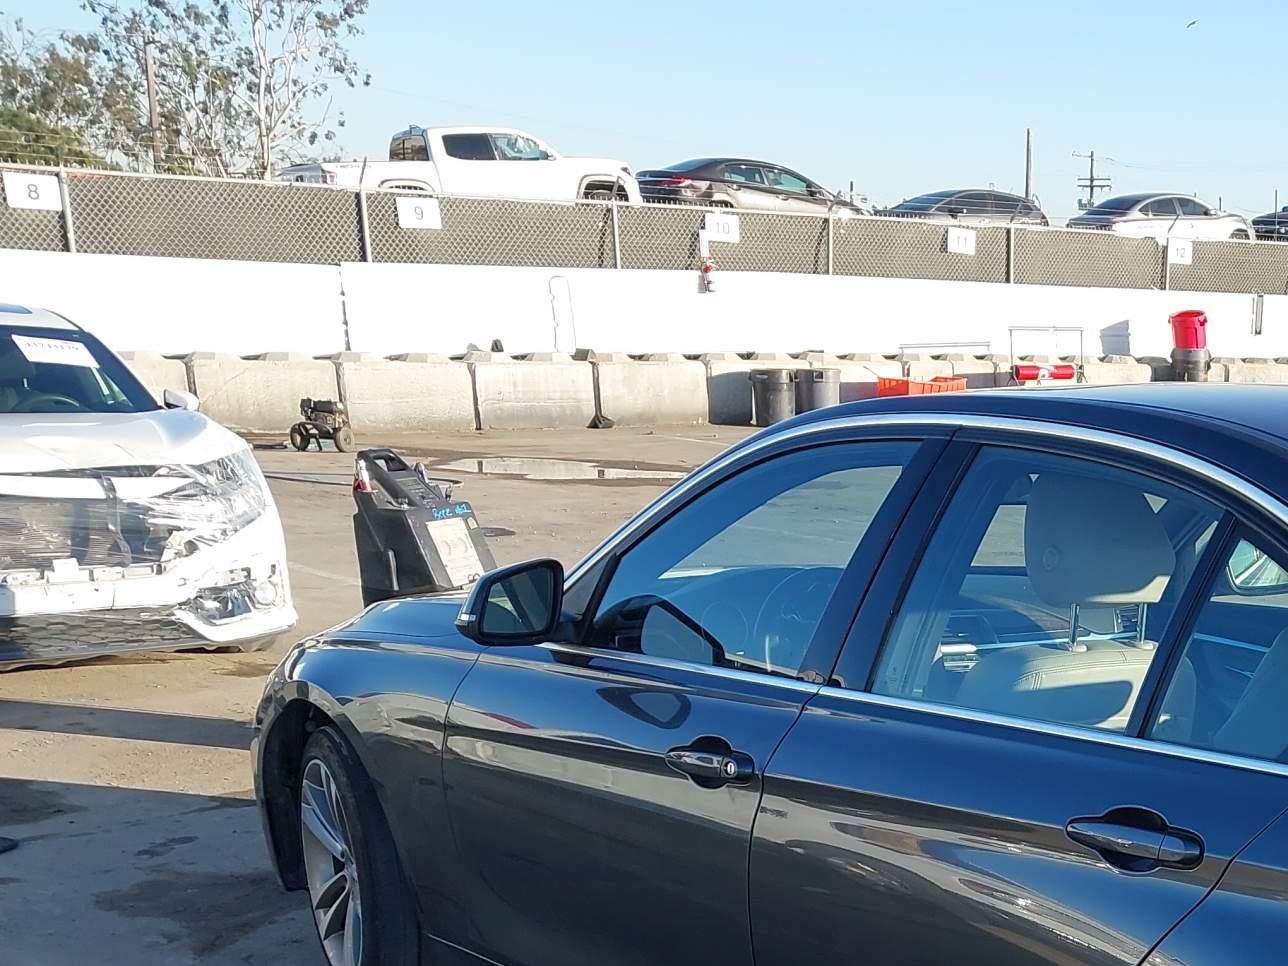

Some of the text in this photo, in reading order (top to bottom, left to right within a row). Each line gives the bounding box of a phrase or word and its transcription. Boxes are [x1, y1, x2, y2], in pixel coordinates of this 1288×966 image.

[27, 183, 40, 200] 8
[414, 206, 424, 221] 9
[715, 222, 730, 235] 10
[956, 235, 968, 250] 11
[1176, 247, 1186, 258] 12
